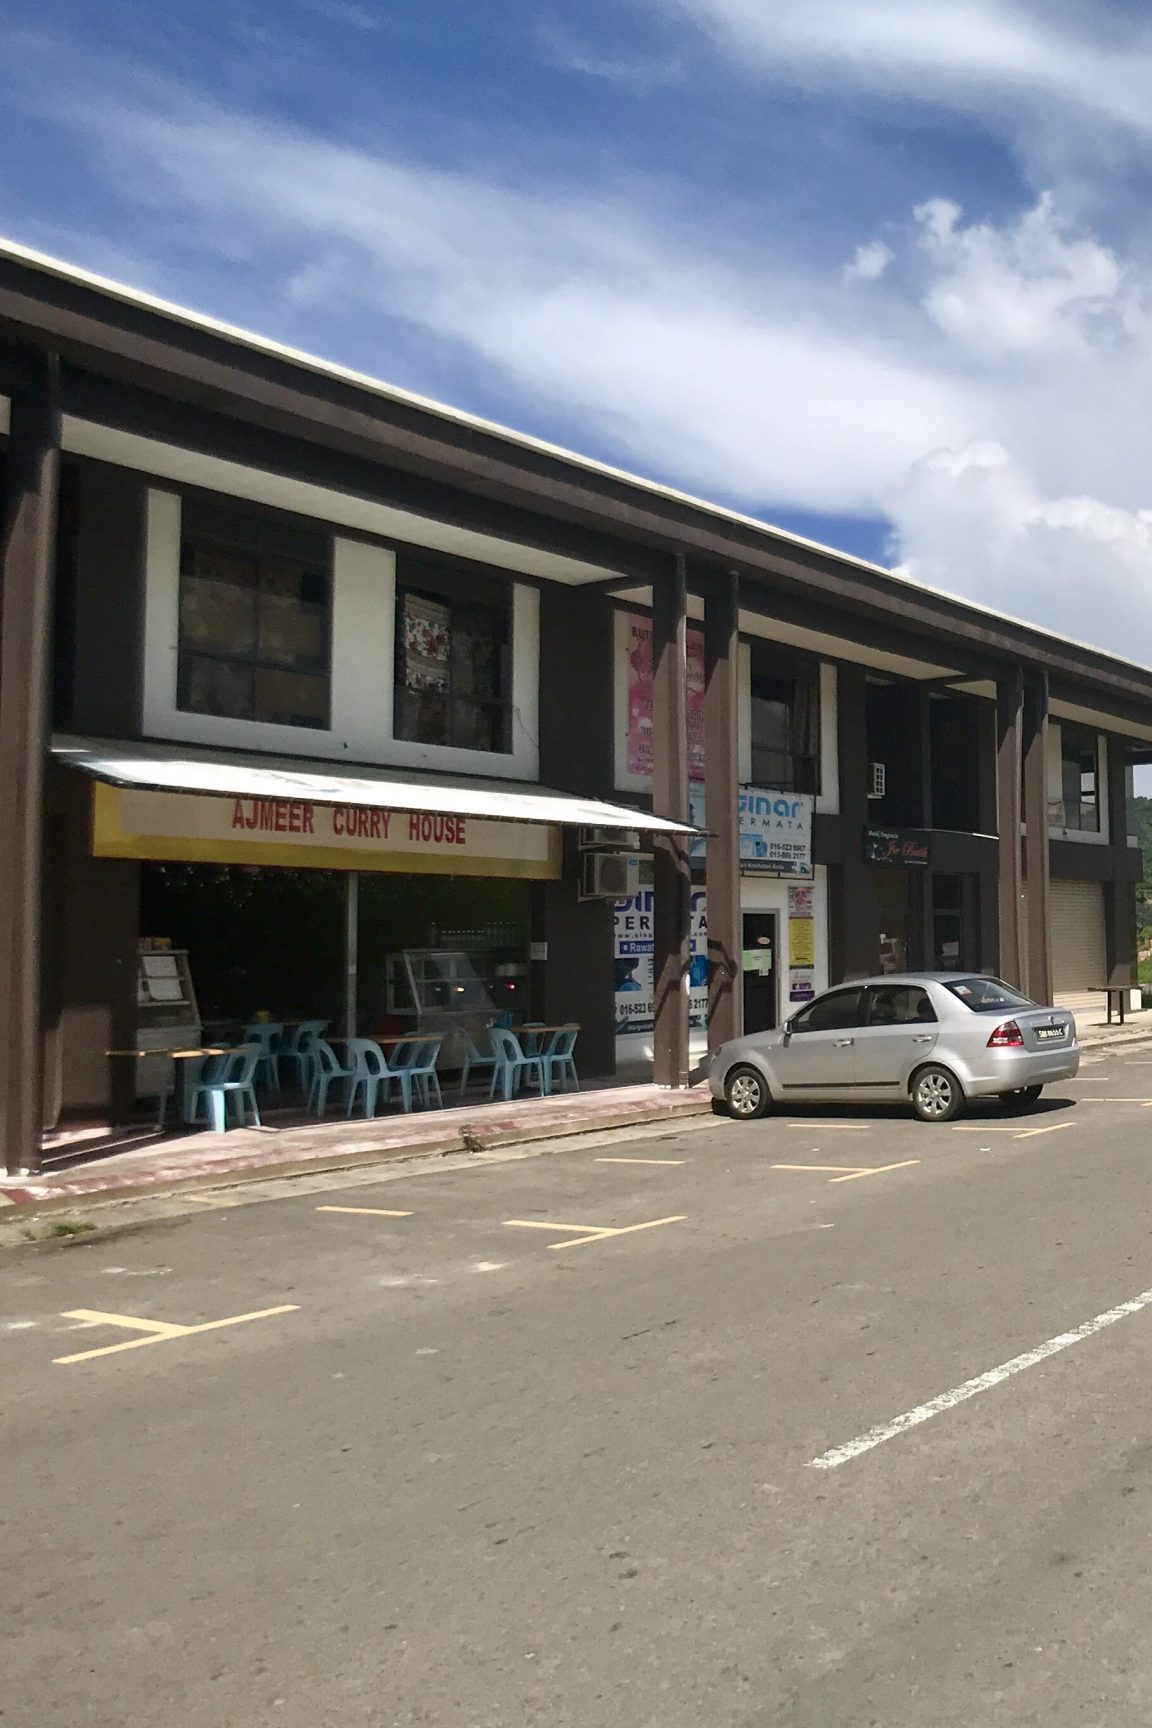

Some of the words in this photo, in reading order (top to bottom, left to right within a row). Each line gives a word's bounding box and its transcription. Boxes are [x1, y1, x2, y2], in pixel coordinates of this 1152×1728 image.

[232, 800, 315, 834] AJMEER
[332, 808, 391, 839] CURRY
[408, 814, 467, 844] HOUSE
[739, 816, 804, 830] ERMATA
